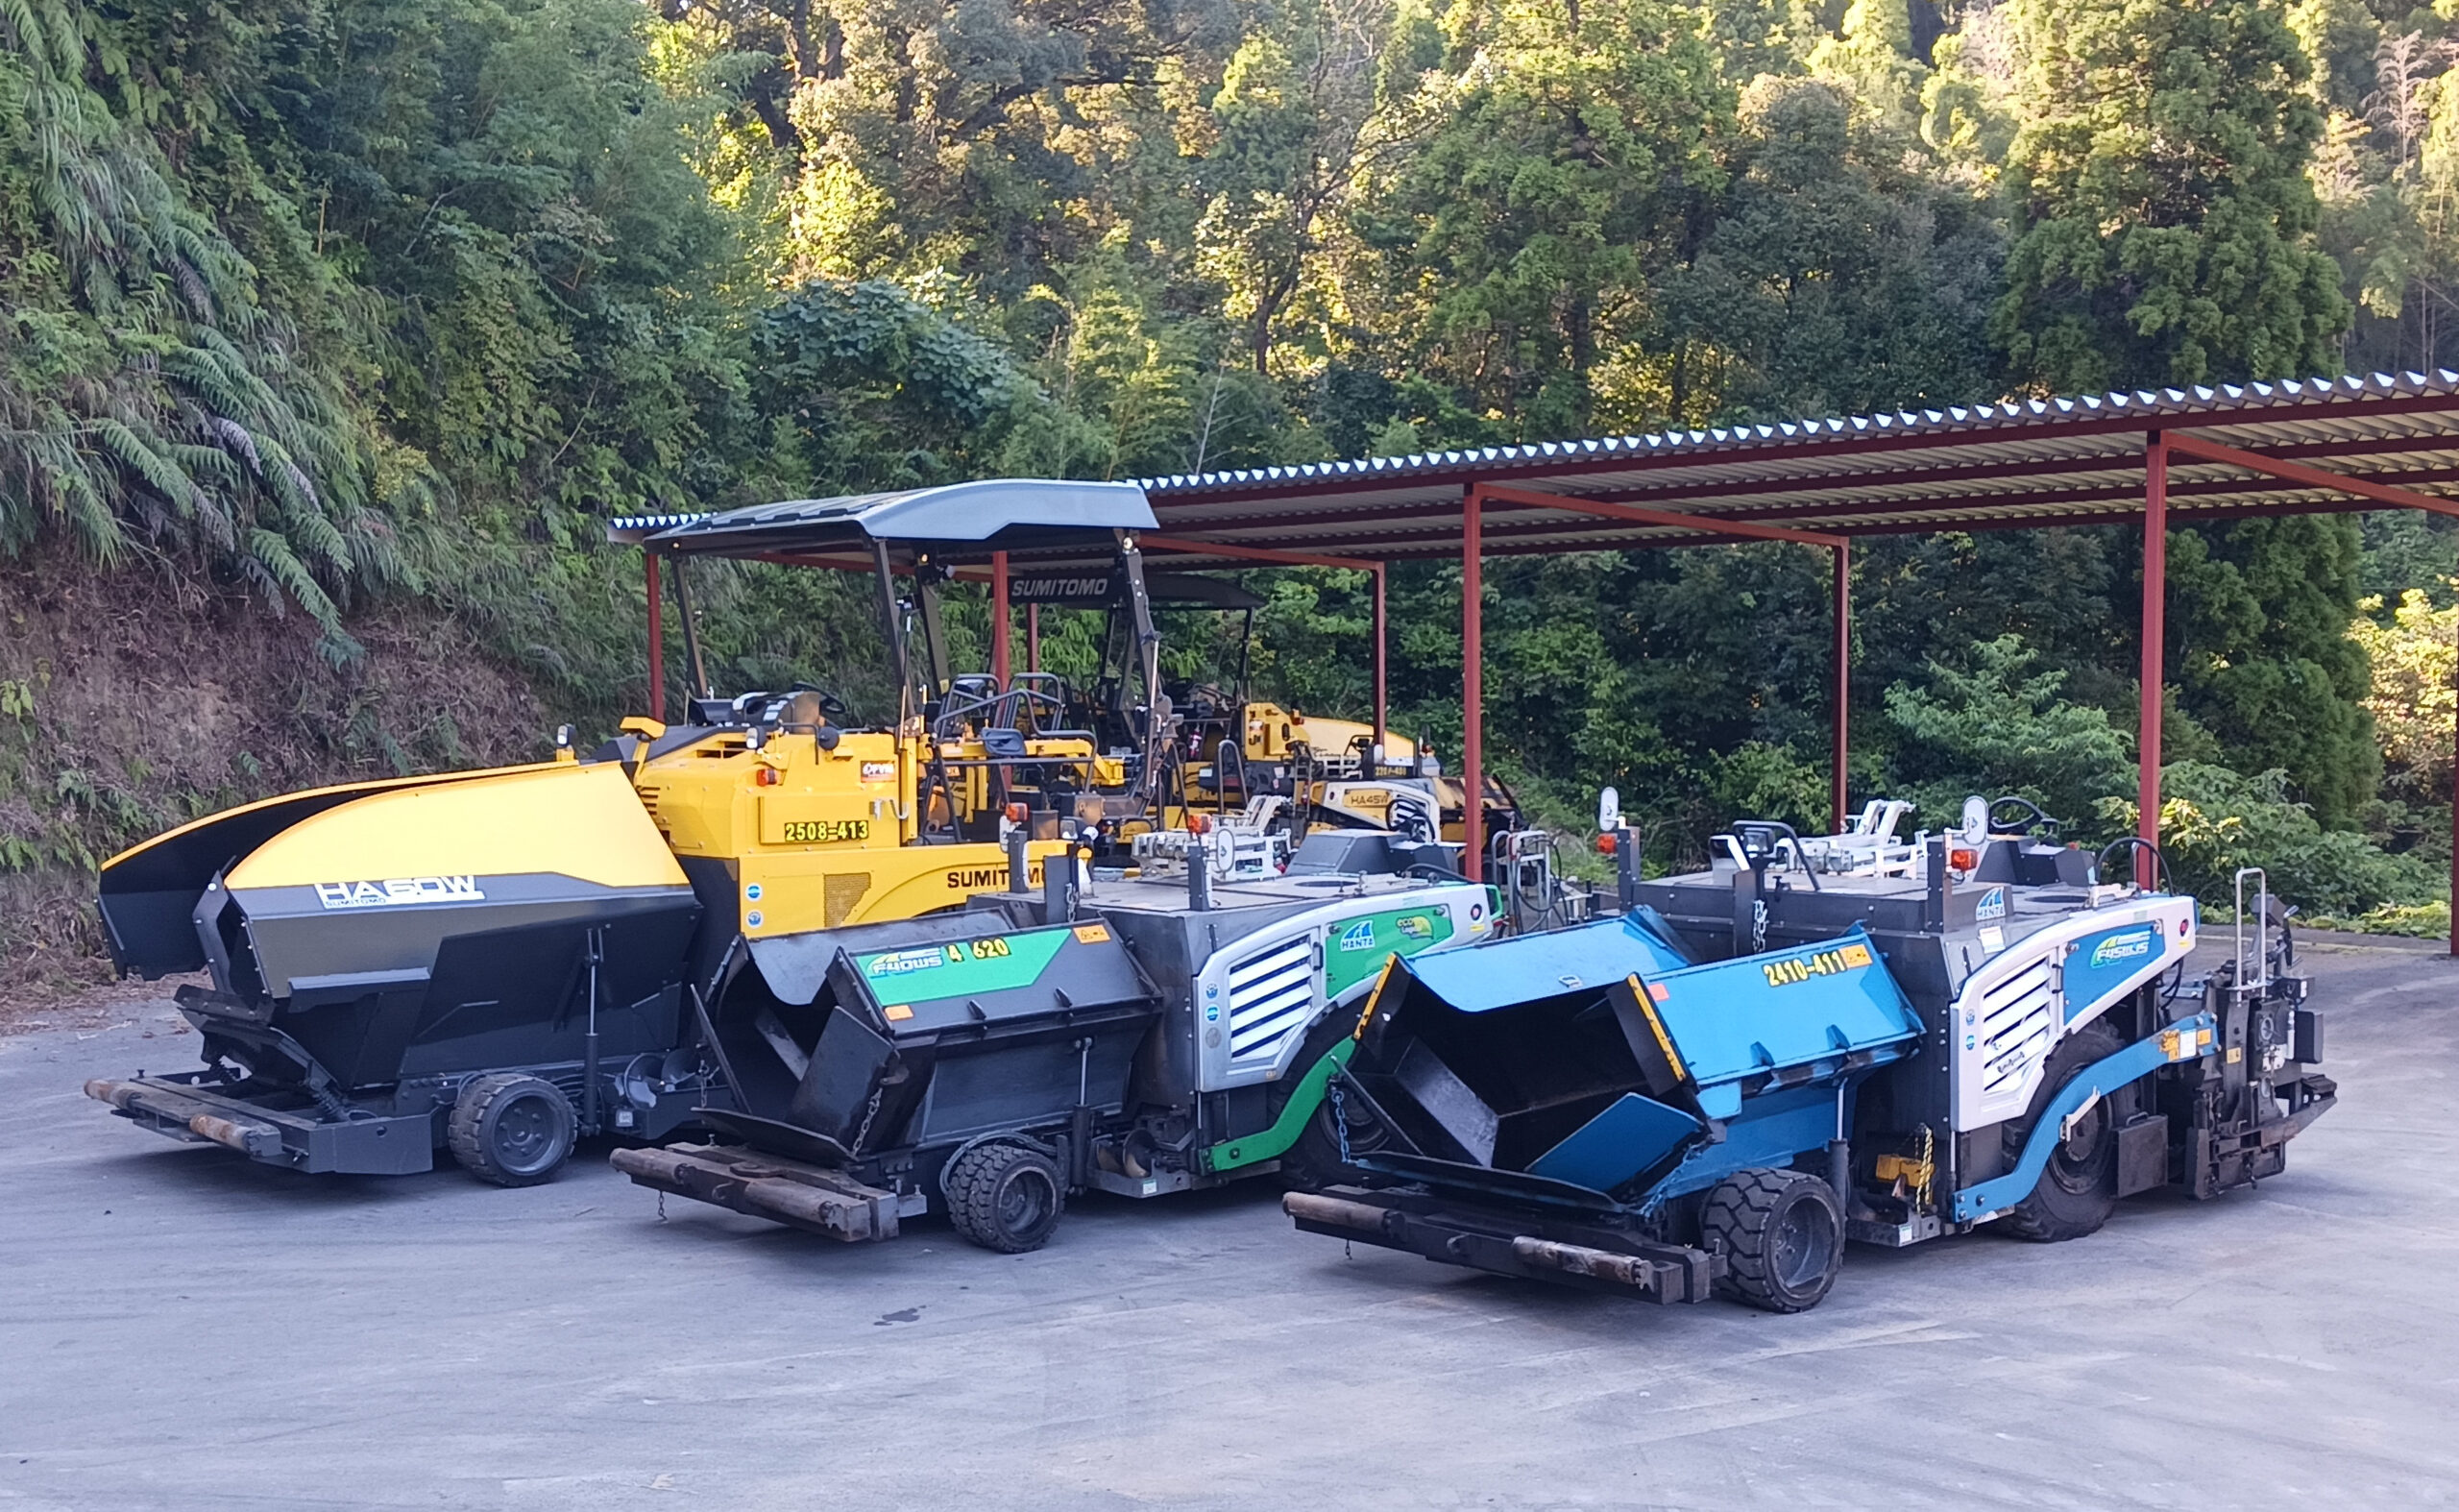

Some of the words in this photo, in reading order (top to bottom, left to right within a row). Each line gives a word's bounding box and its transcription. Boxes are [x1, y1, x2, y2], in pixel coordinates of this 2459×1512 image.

[1011, 578, 1108, 597] SUMITOMO
[785, 820, 868, 841] 2508-413
[972, 939, 1010, 959] 620
[1341, 938, 1374, 949] HANTA
[1764, 952, 1846, 986] 2410-411
